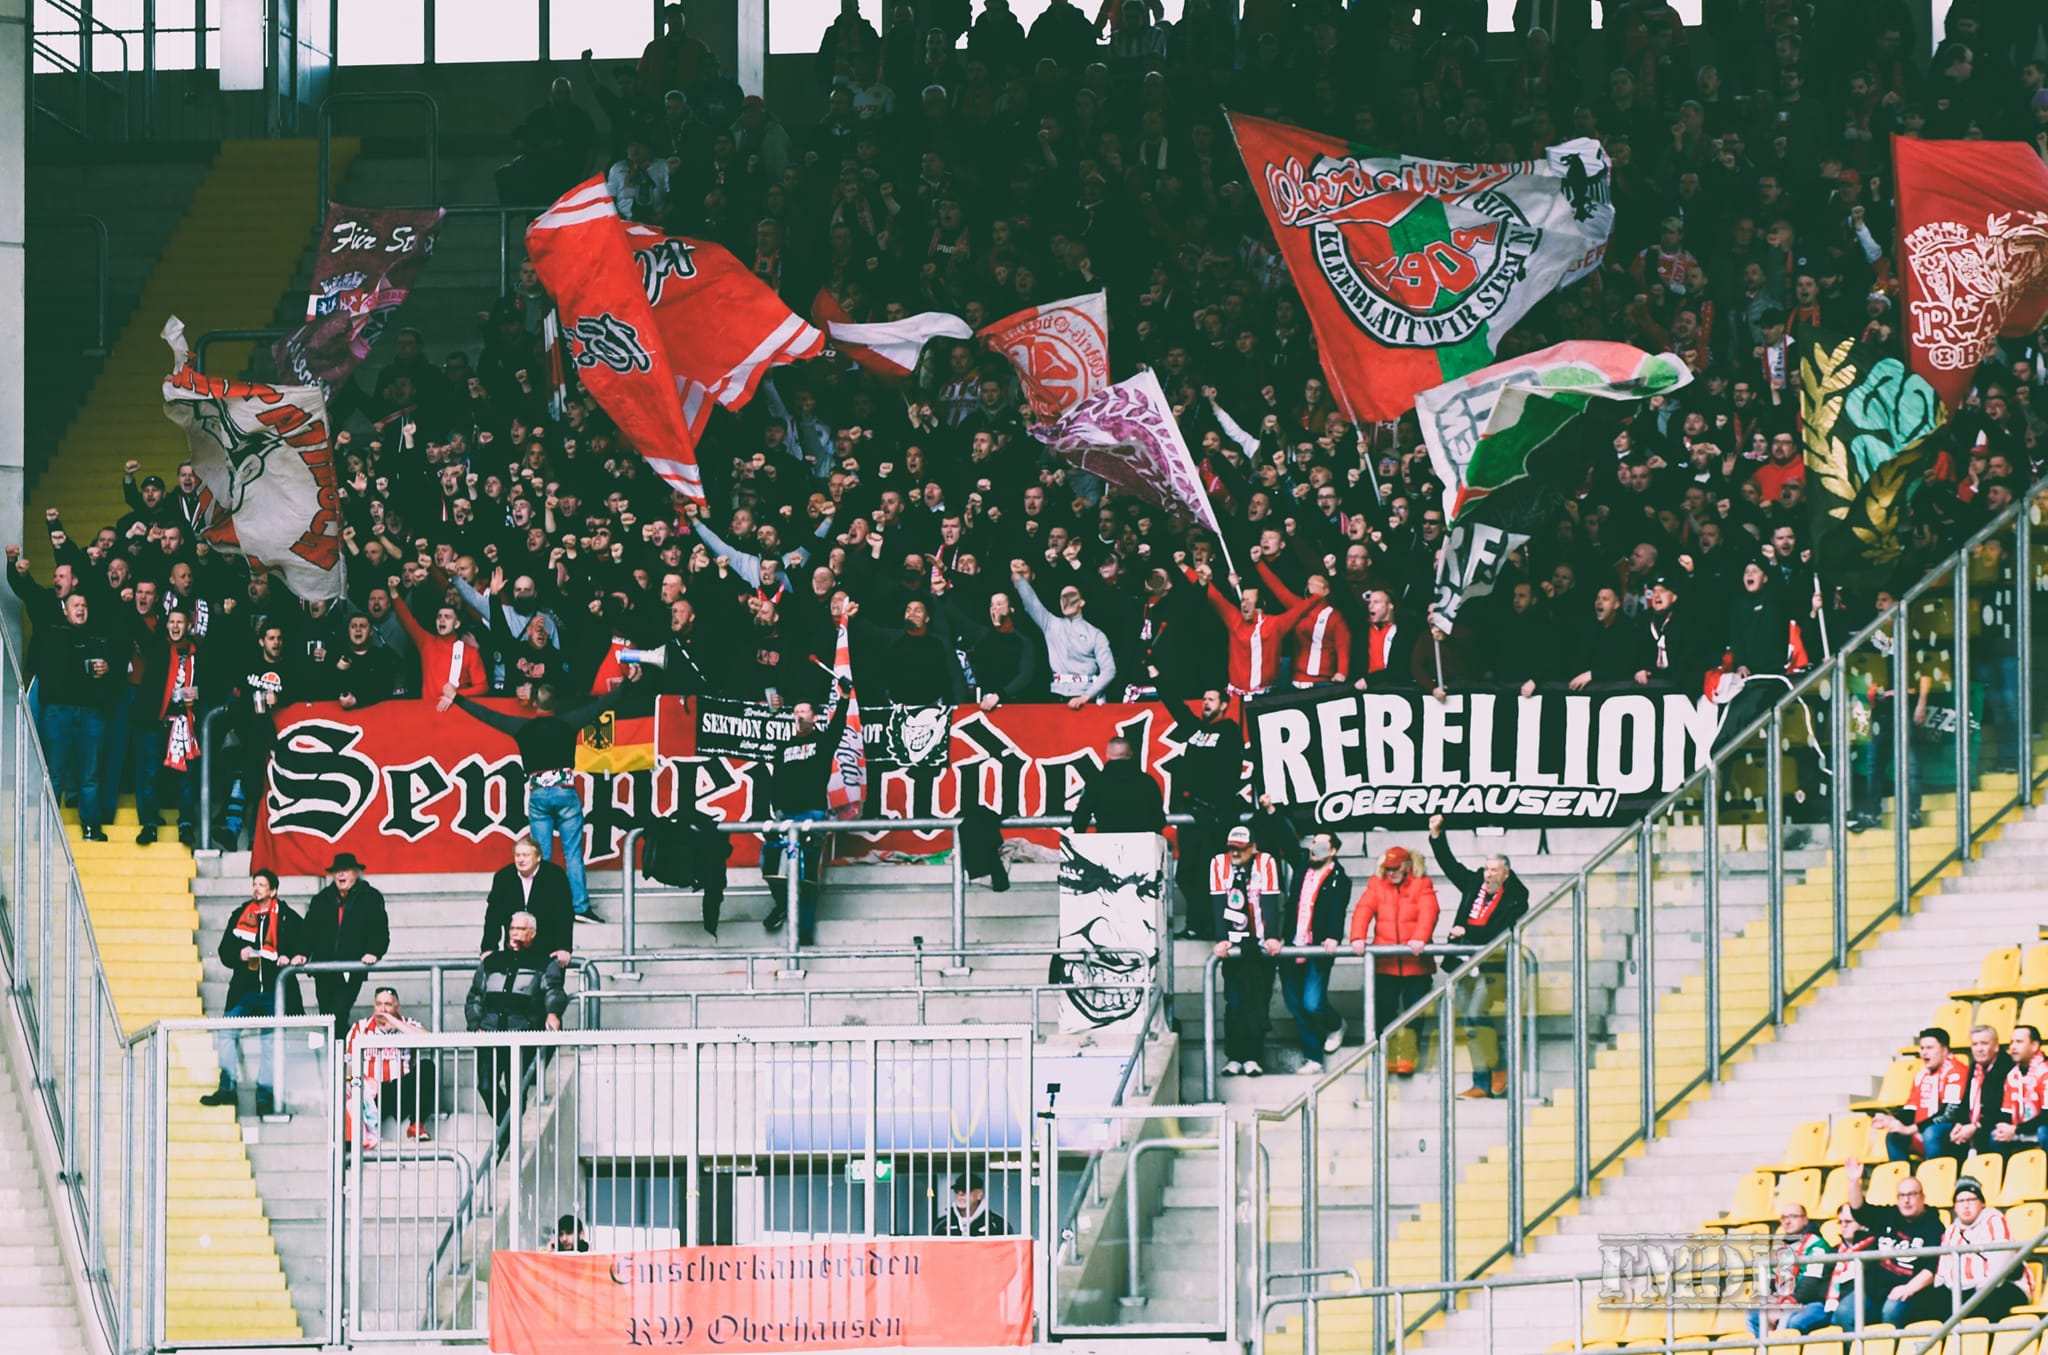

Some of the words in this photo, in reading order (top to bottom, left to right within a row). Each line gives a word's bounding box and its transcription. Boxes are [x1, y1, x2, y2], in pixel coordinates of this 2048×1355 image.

[331, 221, 377, 253] Für
[1319, 229, 1422, 343] KLEEBLATT
[1421, 302, 1480, 343] WIR
[702, 712, 762, 740] SEKTION
[1257, 693, 1725, 804] REBELLION
[1321, 787, 1612, 820] OBERHAUSEN
[628, 1315, 694, 1346] RW
[707, 1313, 901, 1345] Oberhausen
